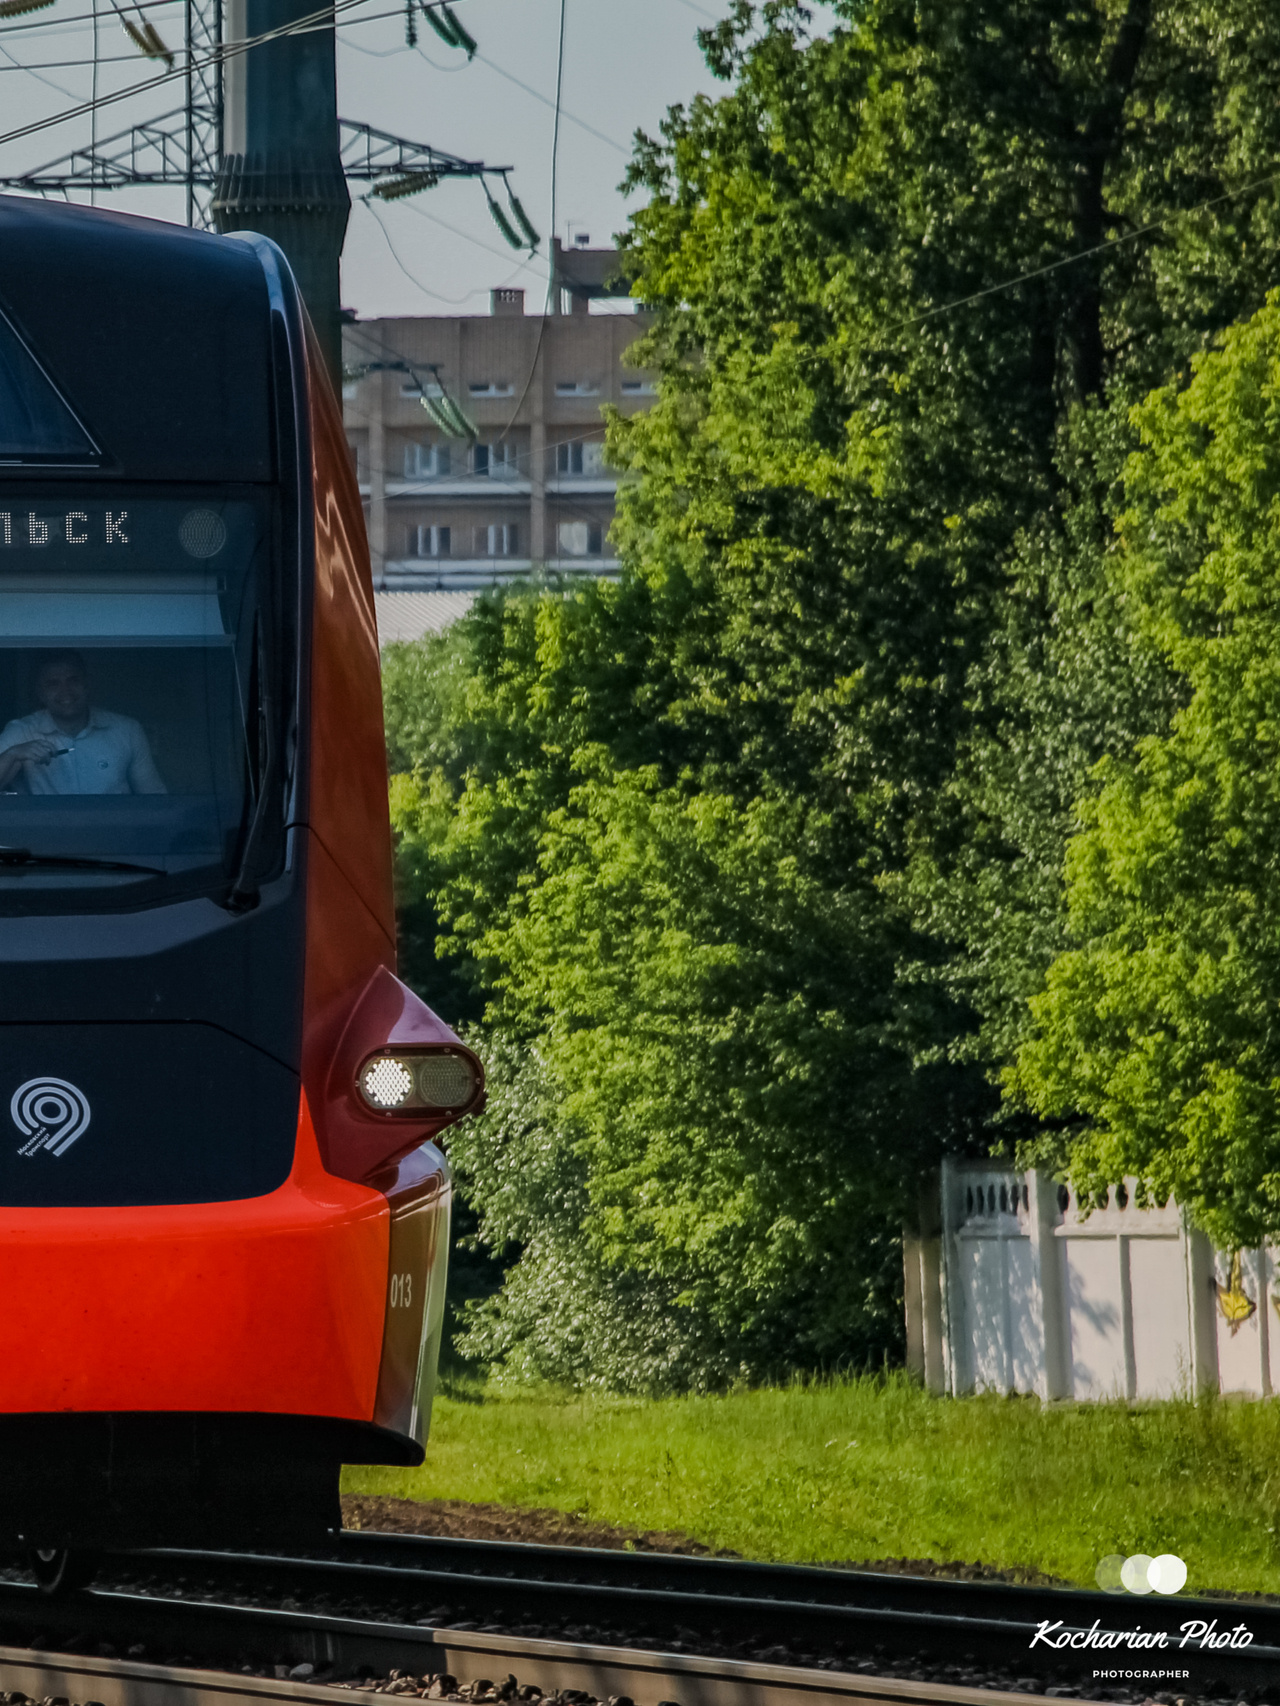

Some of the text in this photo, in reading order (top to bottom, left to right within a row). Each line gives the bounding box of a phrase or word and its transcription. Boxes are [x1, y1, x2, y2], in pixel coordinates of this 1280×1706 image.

[17, 1126, 47, 1156] Московский
[24, 1133, 51, 1158] Транспорт
[390, 1273, 412, 1308] 013
